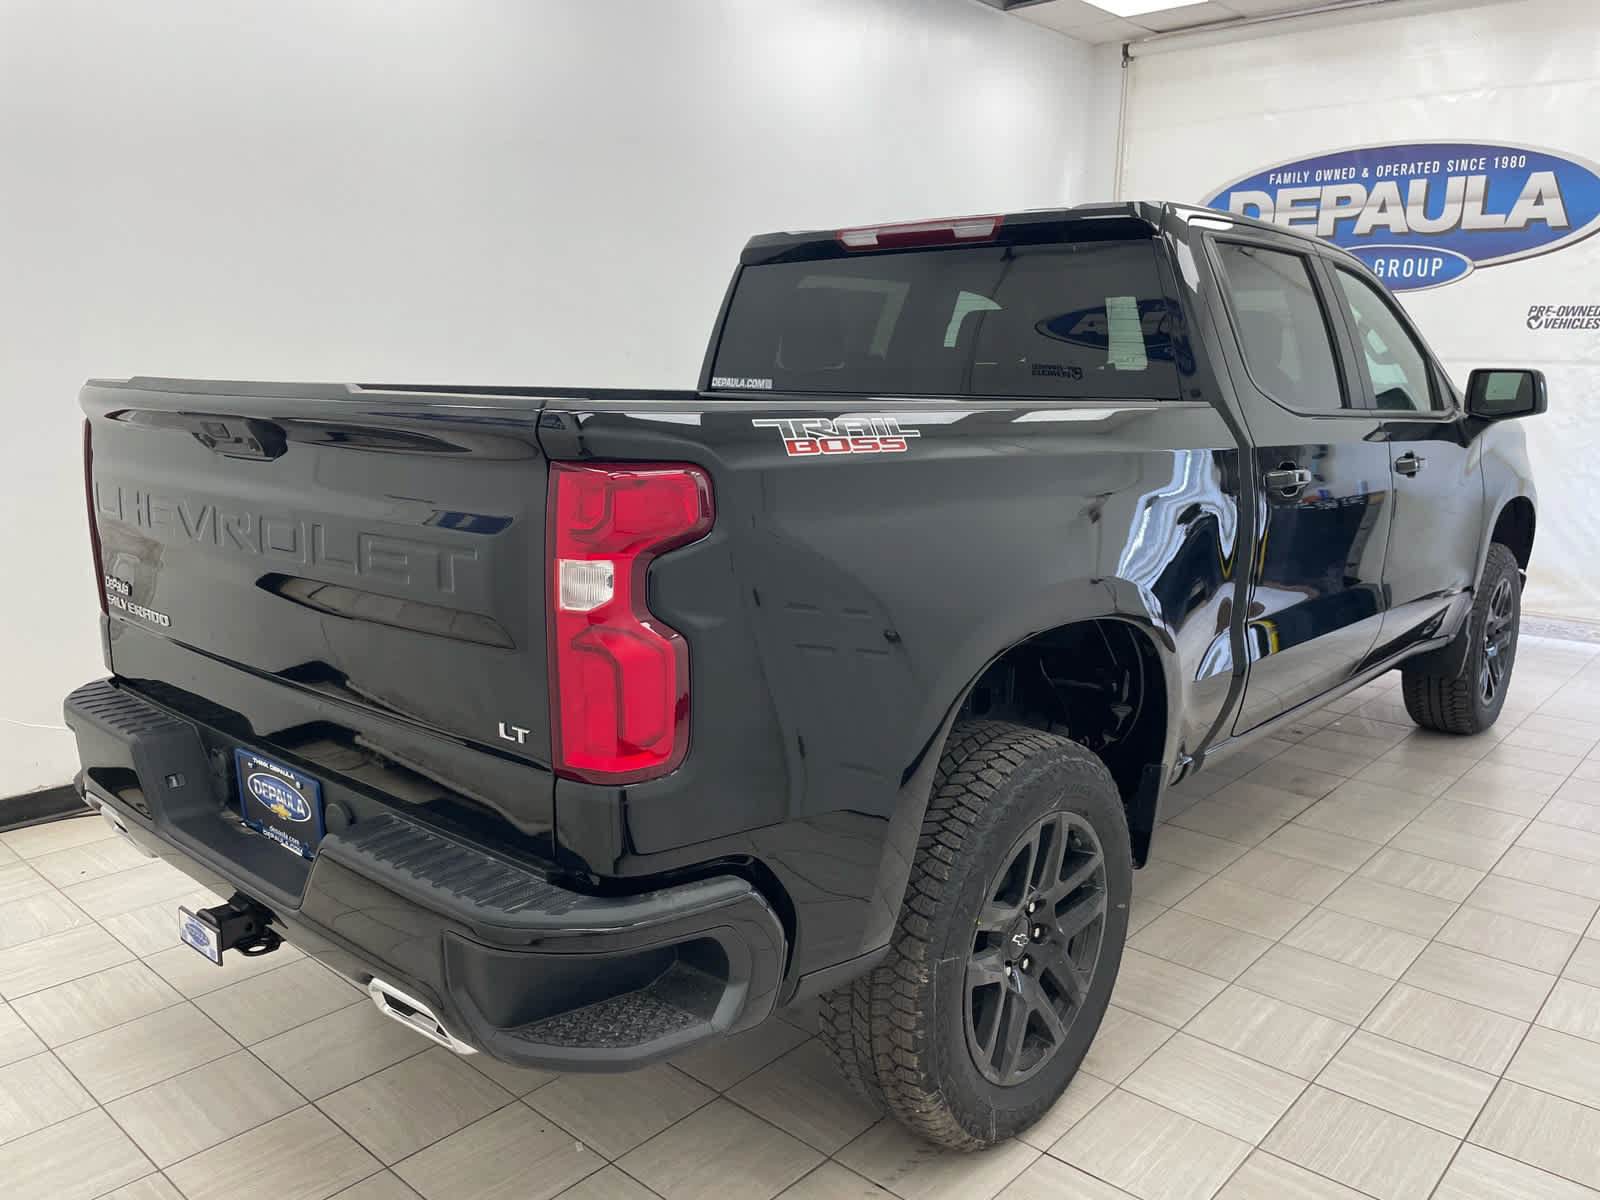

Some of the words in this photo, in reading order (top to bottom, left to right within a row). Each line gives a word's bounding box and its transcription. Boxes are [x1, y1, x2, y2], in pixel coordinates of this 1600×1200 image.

[1269, 170, 1310, 185] FAMILY
[1315, 167, 1356, 182] OWNED
[1361, 167, 1369, 178] &
[1376, 160, 1440, 178] OPERATED
[1447, 157, 1486, 173] SINCE
[1493, 155, 1527, 169] 1980
[1229, 170, 1570, 239] DEPAULA
[1373, 257, 1443, 278] GROUP
[1544, 317, 1600, 330] VEHICLES
[711, 376, 765, 389] DEPAULA.COM
[752, 417, 921, 439] TRAIL
[784, 436, 908, 456] BOSS
[95, 482, 478, 593] CHEVROLET
[106, 593, 170, 627] SILVERADO
[498, 721, 530, 744] LT
[253, 778, 306, 818] DEPAULA
